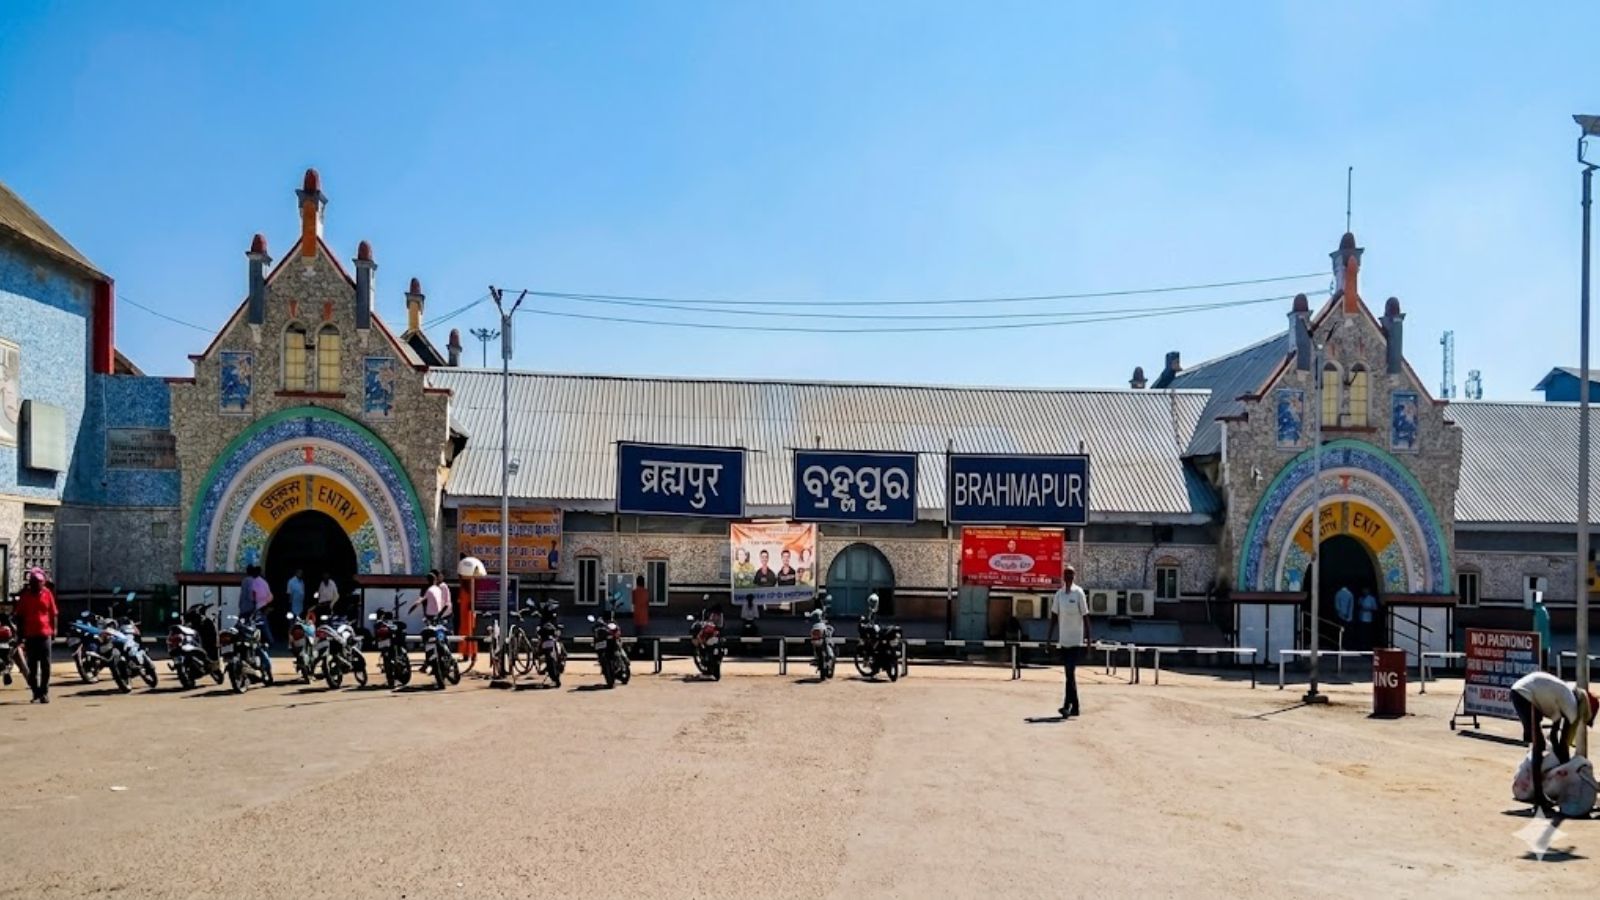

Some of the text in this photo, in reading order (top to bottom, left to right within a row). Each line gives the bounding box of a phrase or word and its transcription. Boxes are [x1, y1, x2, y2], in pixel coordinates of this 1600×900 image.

[640, 460, 723, 509] ब्रह्मपुर
[955, 472, 1083, 507] BRAHMAPUR
[318, 485, 357, 521] ENTRY
[1353, 511, 1381, 537] EXIT
[1471, 632, 1486, 645] NO
